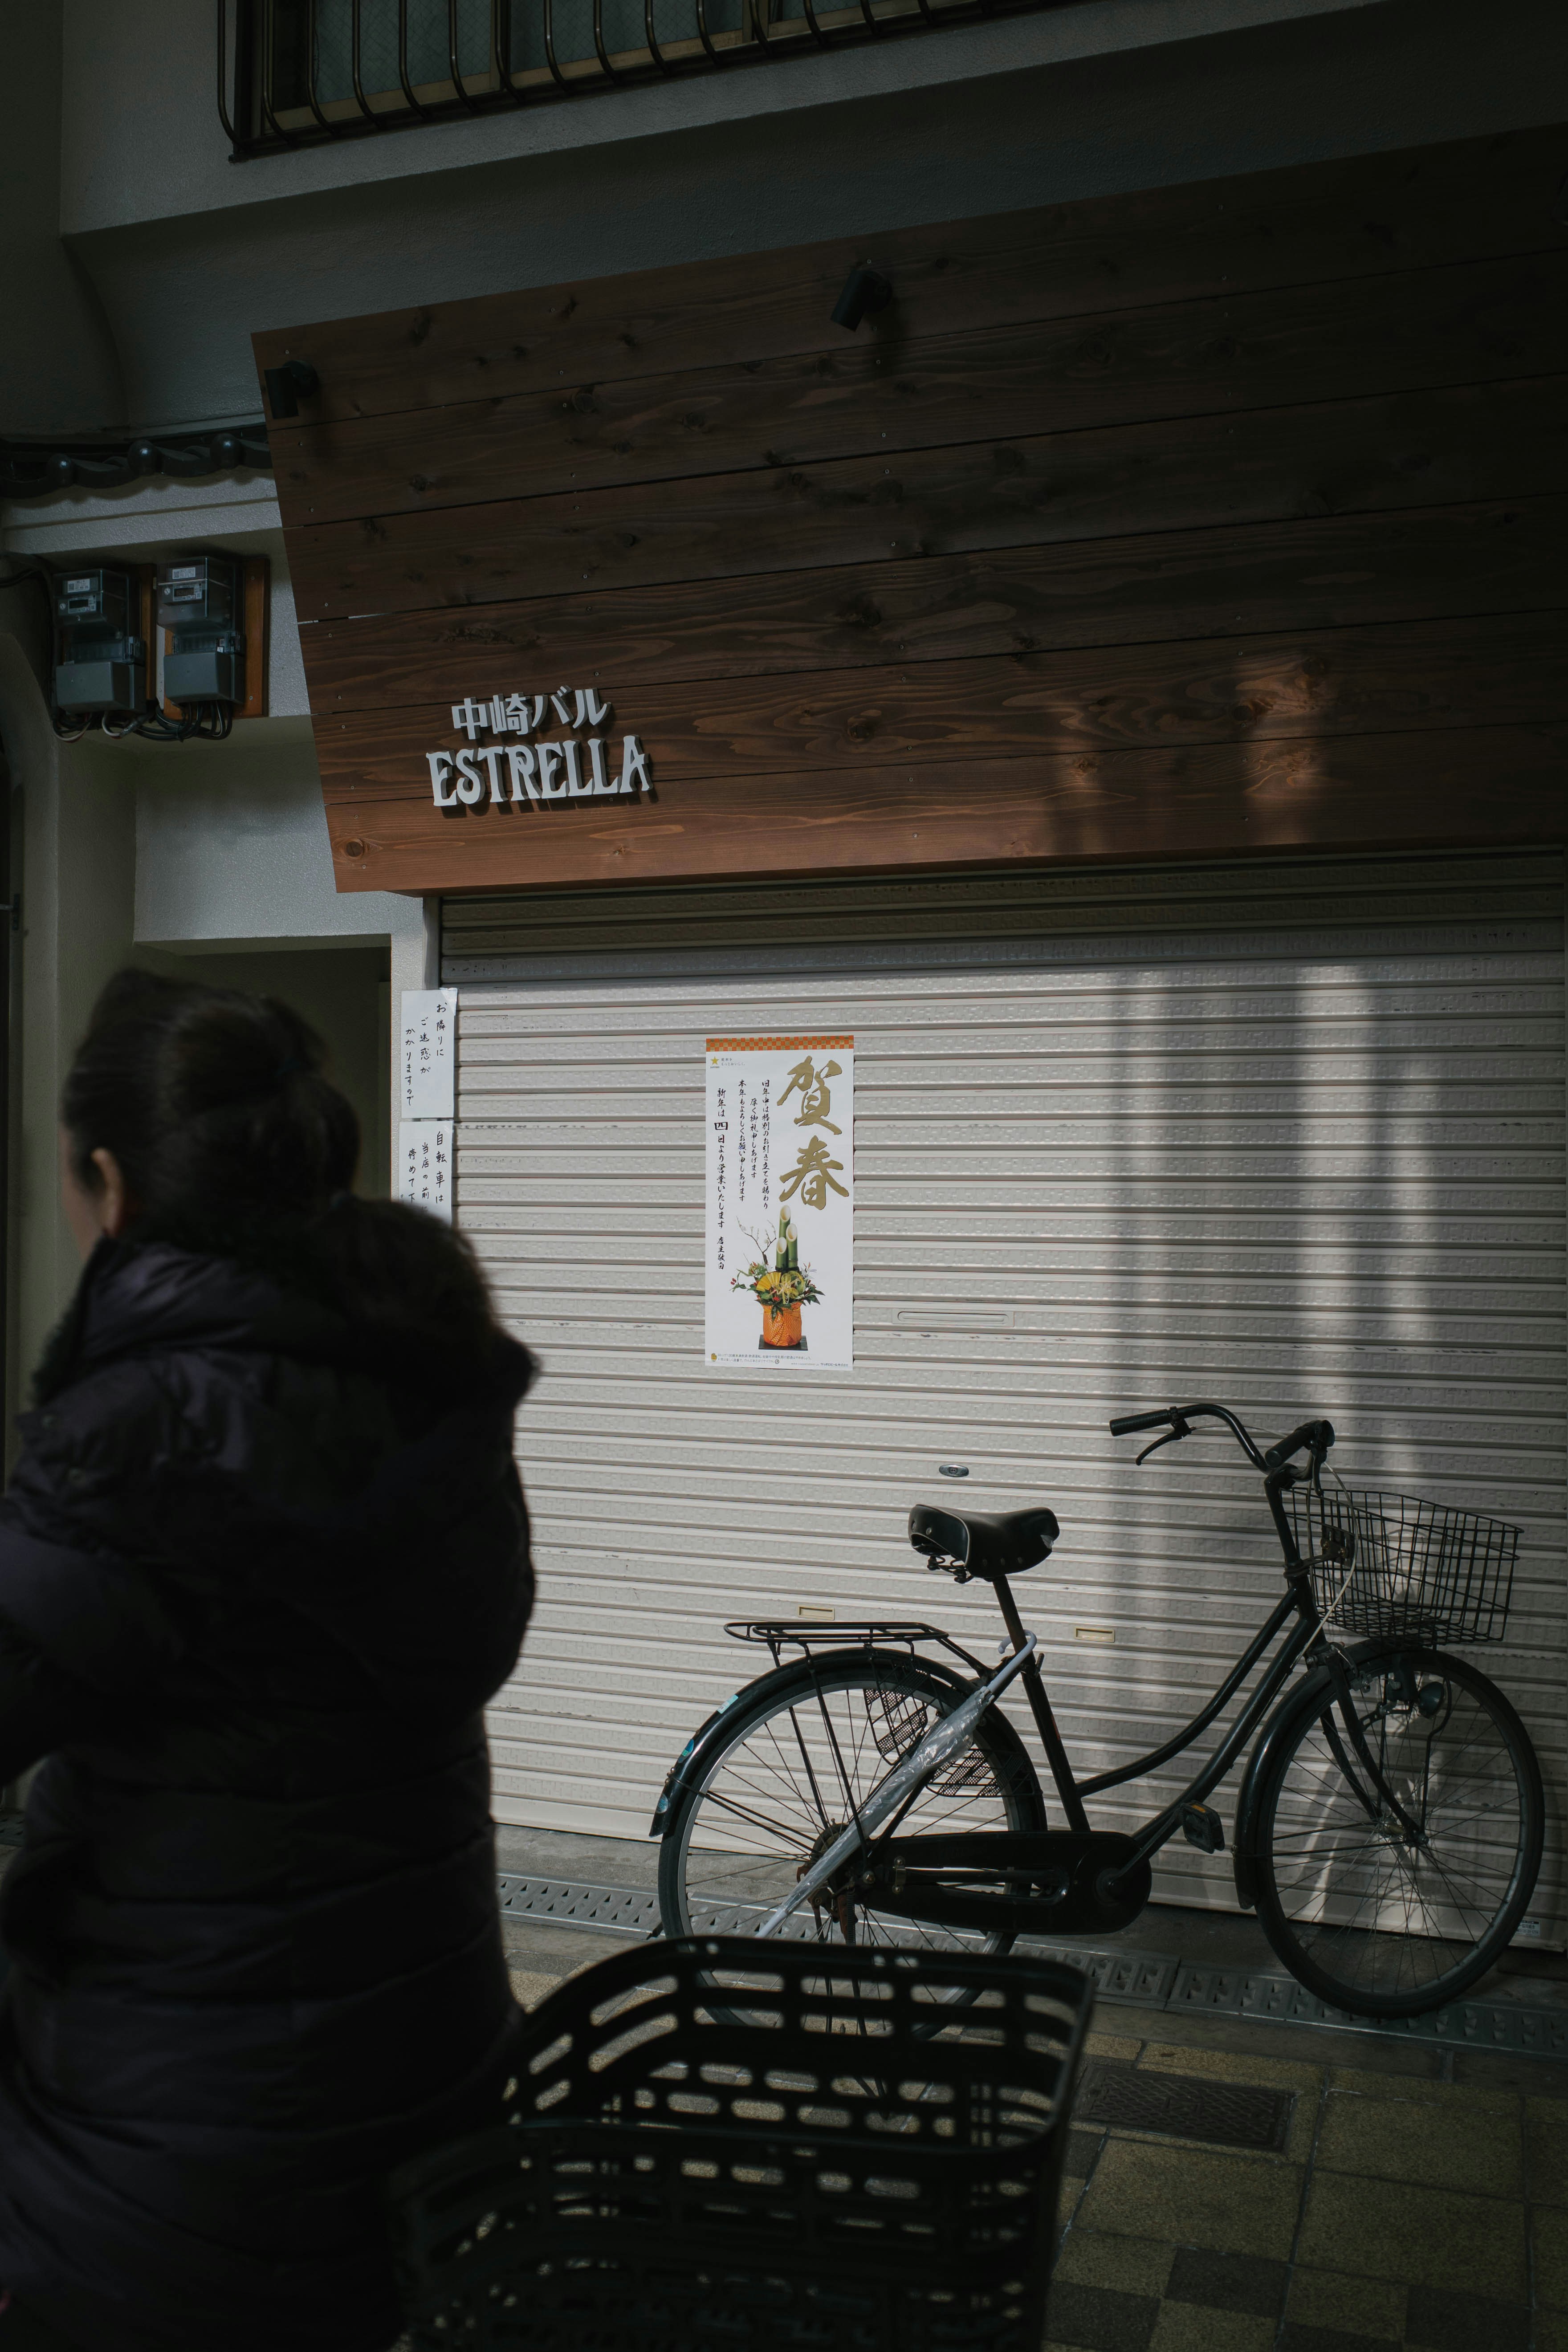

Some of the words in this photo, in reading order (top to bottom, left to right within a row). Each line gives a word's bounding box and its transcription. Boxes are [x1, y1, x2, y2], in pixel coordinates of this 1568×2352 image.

[451, 685, 612, 740] 中崎バル
[426, 734, 653, 806] ESTRELLA
[419, 1017, 431, 1074] ご迷惑が
[436, 1002, 448, 1056] お隣りに
[404, 1029, 415, 1106] かかりますので
[436, 1131, 447, 1204] 自転車は
[738, 1079, 746, 1201] 本年もよろしくお願い申しあげます
[750, 1098, 758, 1179] 厚く御礼申しあげます
[777, 1055, 849, 1210] 賀春
